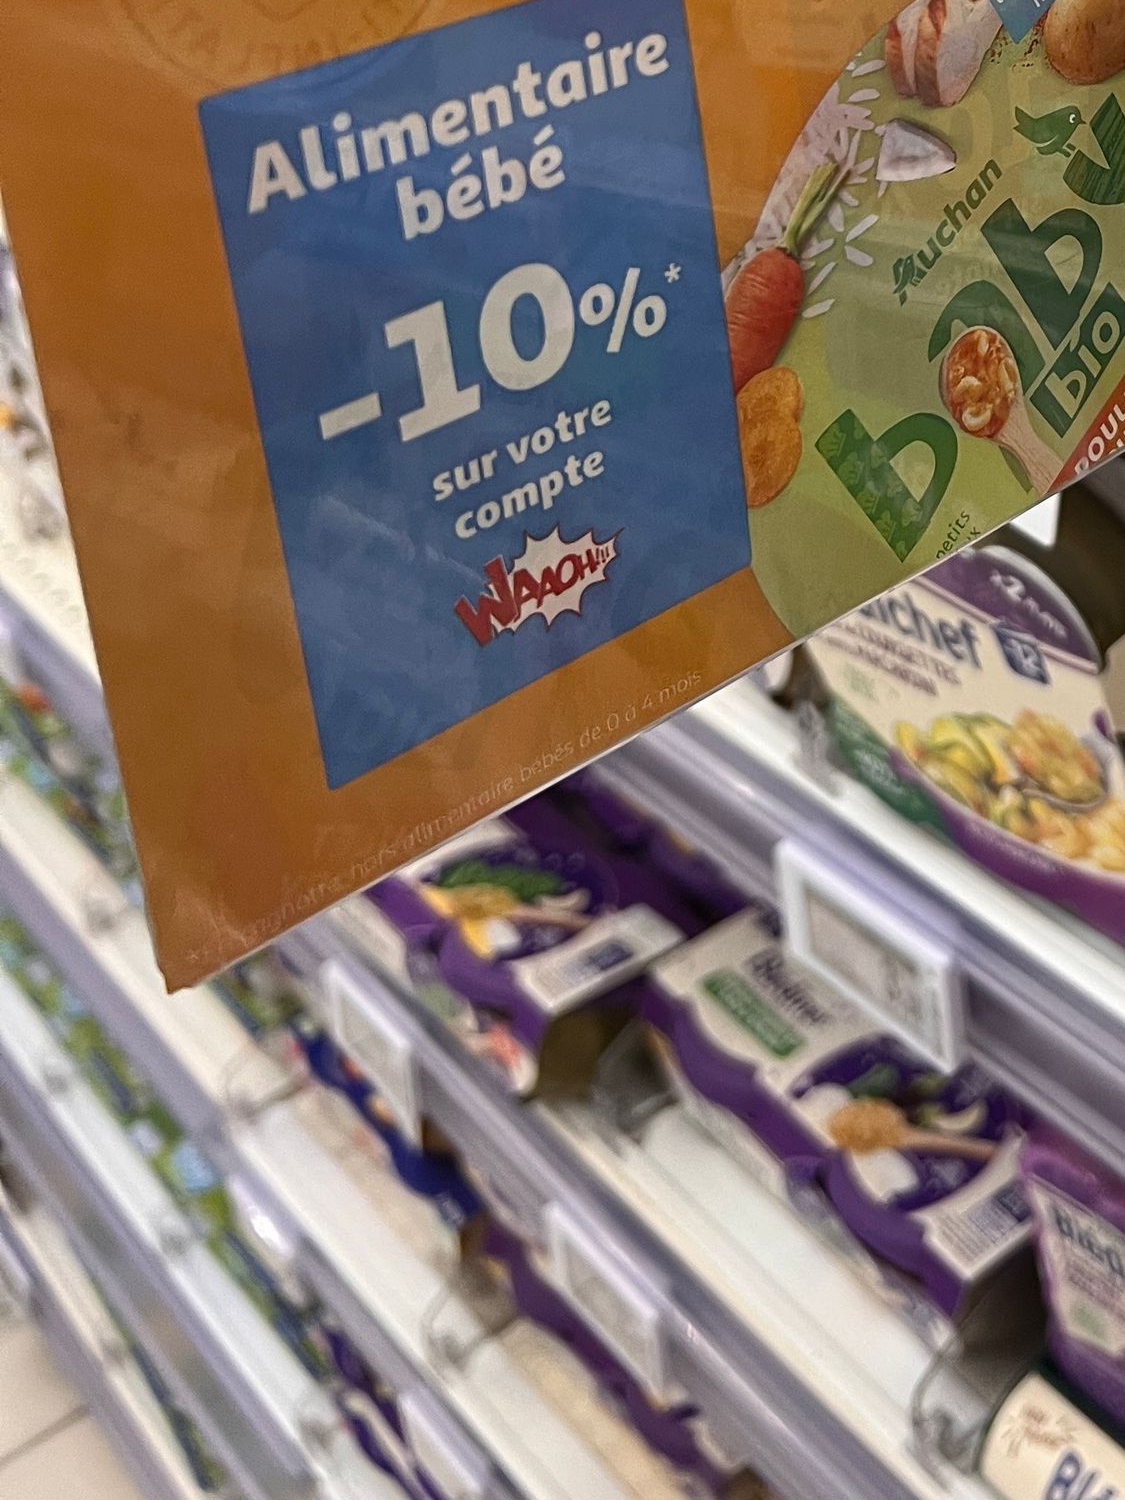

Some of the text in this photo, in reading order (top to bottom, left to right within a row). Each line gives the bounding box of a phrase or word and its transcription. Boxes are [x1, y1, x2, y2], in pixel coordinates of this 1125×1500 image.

[248, 32, 669, 214] Alimentaire
[396, 125, 565, 240] bébé
[892, 159, 1002, 306] Auchan
[1045, 311, 1120, 420] bio
[433, 400, 612, 501] sur votre
[455, 450, 605, 539] compte
